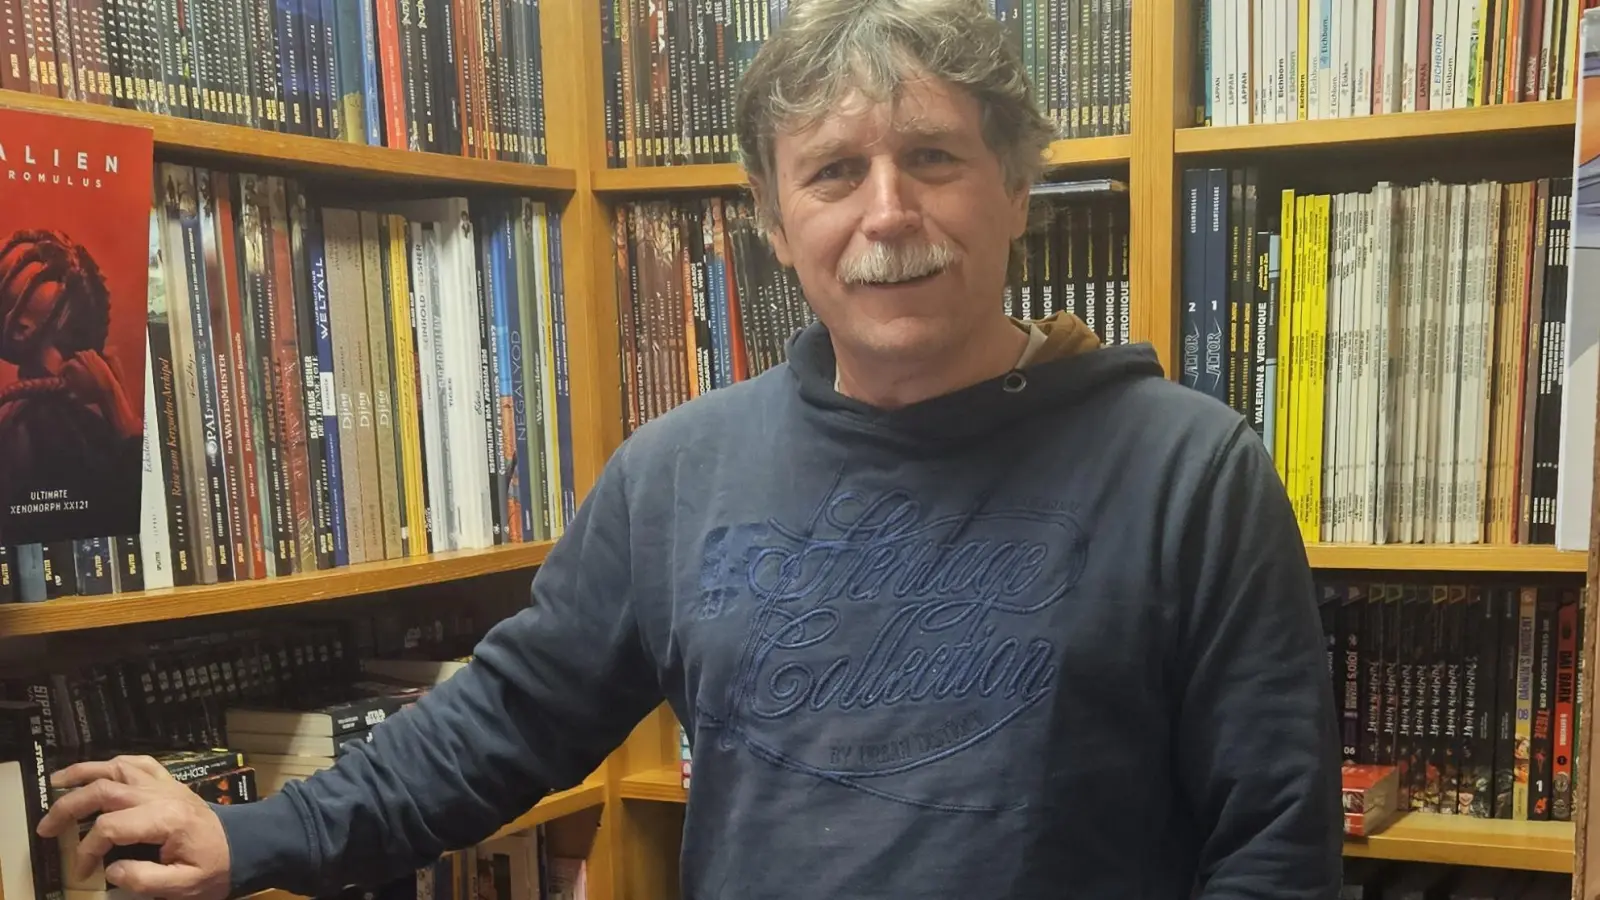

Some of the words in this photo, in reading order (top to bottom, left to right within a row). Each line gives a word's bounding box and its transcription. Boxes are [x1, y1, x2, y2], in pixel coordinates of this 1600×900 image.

[8, 170, 102, 189] ROMULUS
[316, 257, 329, 340] WELTALL
[1120, 280, 1129, 345] VERONIQUE
[1188, 301, 1196, 313] 2
[1211, 300, 1218, 311] 1
[1105, 281, 1115, 345] VERONIQUE
[1257, 302, 1267, 363] VERONIQUE
[304, 355, 315, 387] USHER
[1256, 365, 1265, 373] &
[511, 330, 526, 441] NEGALYOD
[1255, 373, 1265, 424] VALERIAN
[306, 391, 317, 415] HAUS
[308, 419, 318, 439] DAS
[30, 489, 68, 501] ULTIMATE
[171, 474, 182, 497] Reise
[10, 502, 61, 515] XENOMORPH
[63, 500, 89, 511] XX121
[750, 490, 1050, 612] Heritage
[750, 605, 1053, 718] Collection
[33, 740, 44, 776] STAR
[1343, 746, 1356, 756] 06
[38, 775, 49, 810] WARS
[1536, 779, 1543, 792] 1
